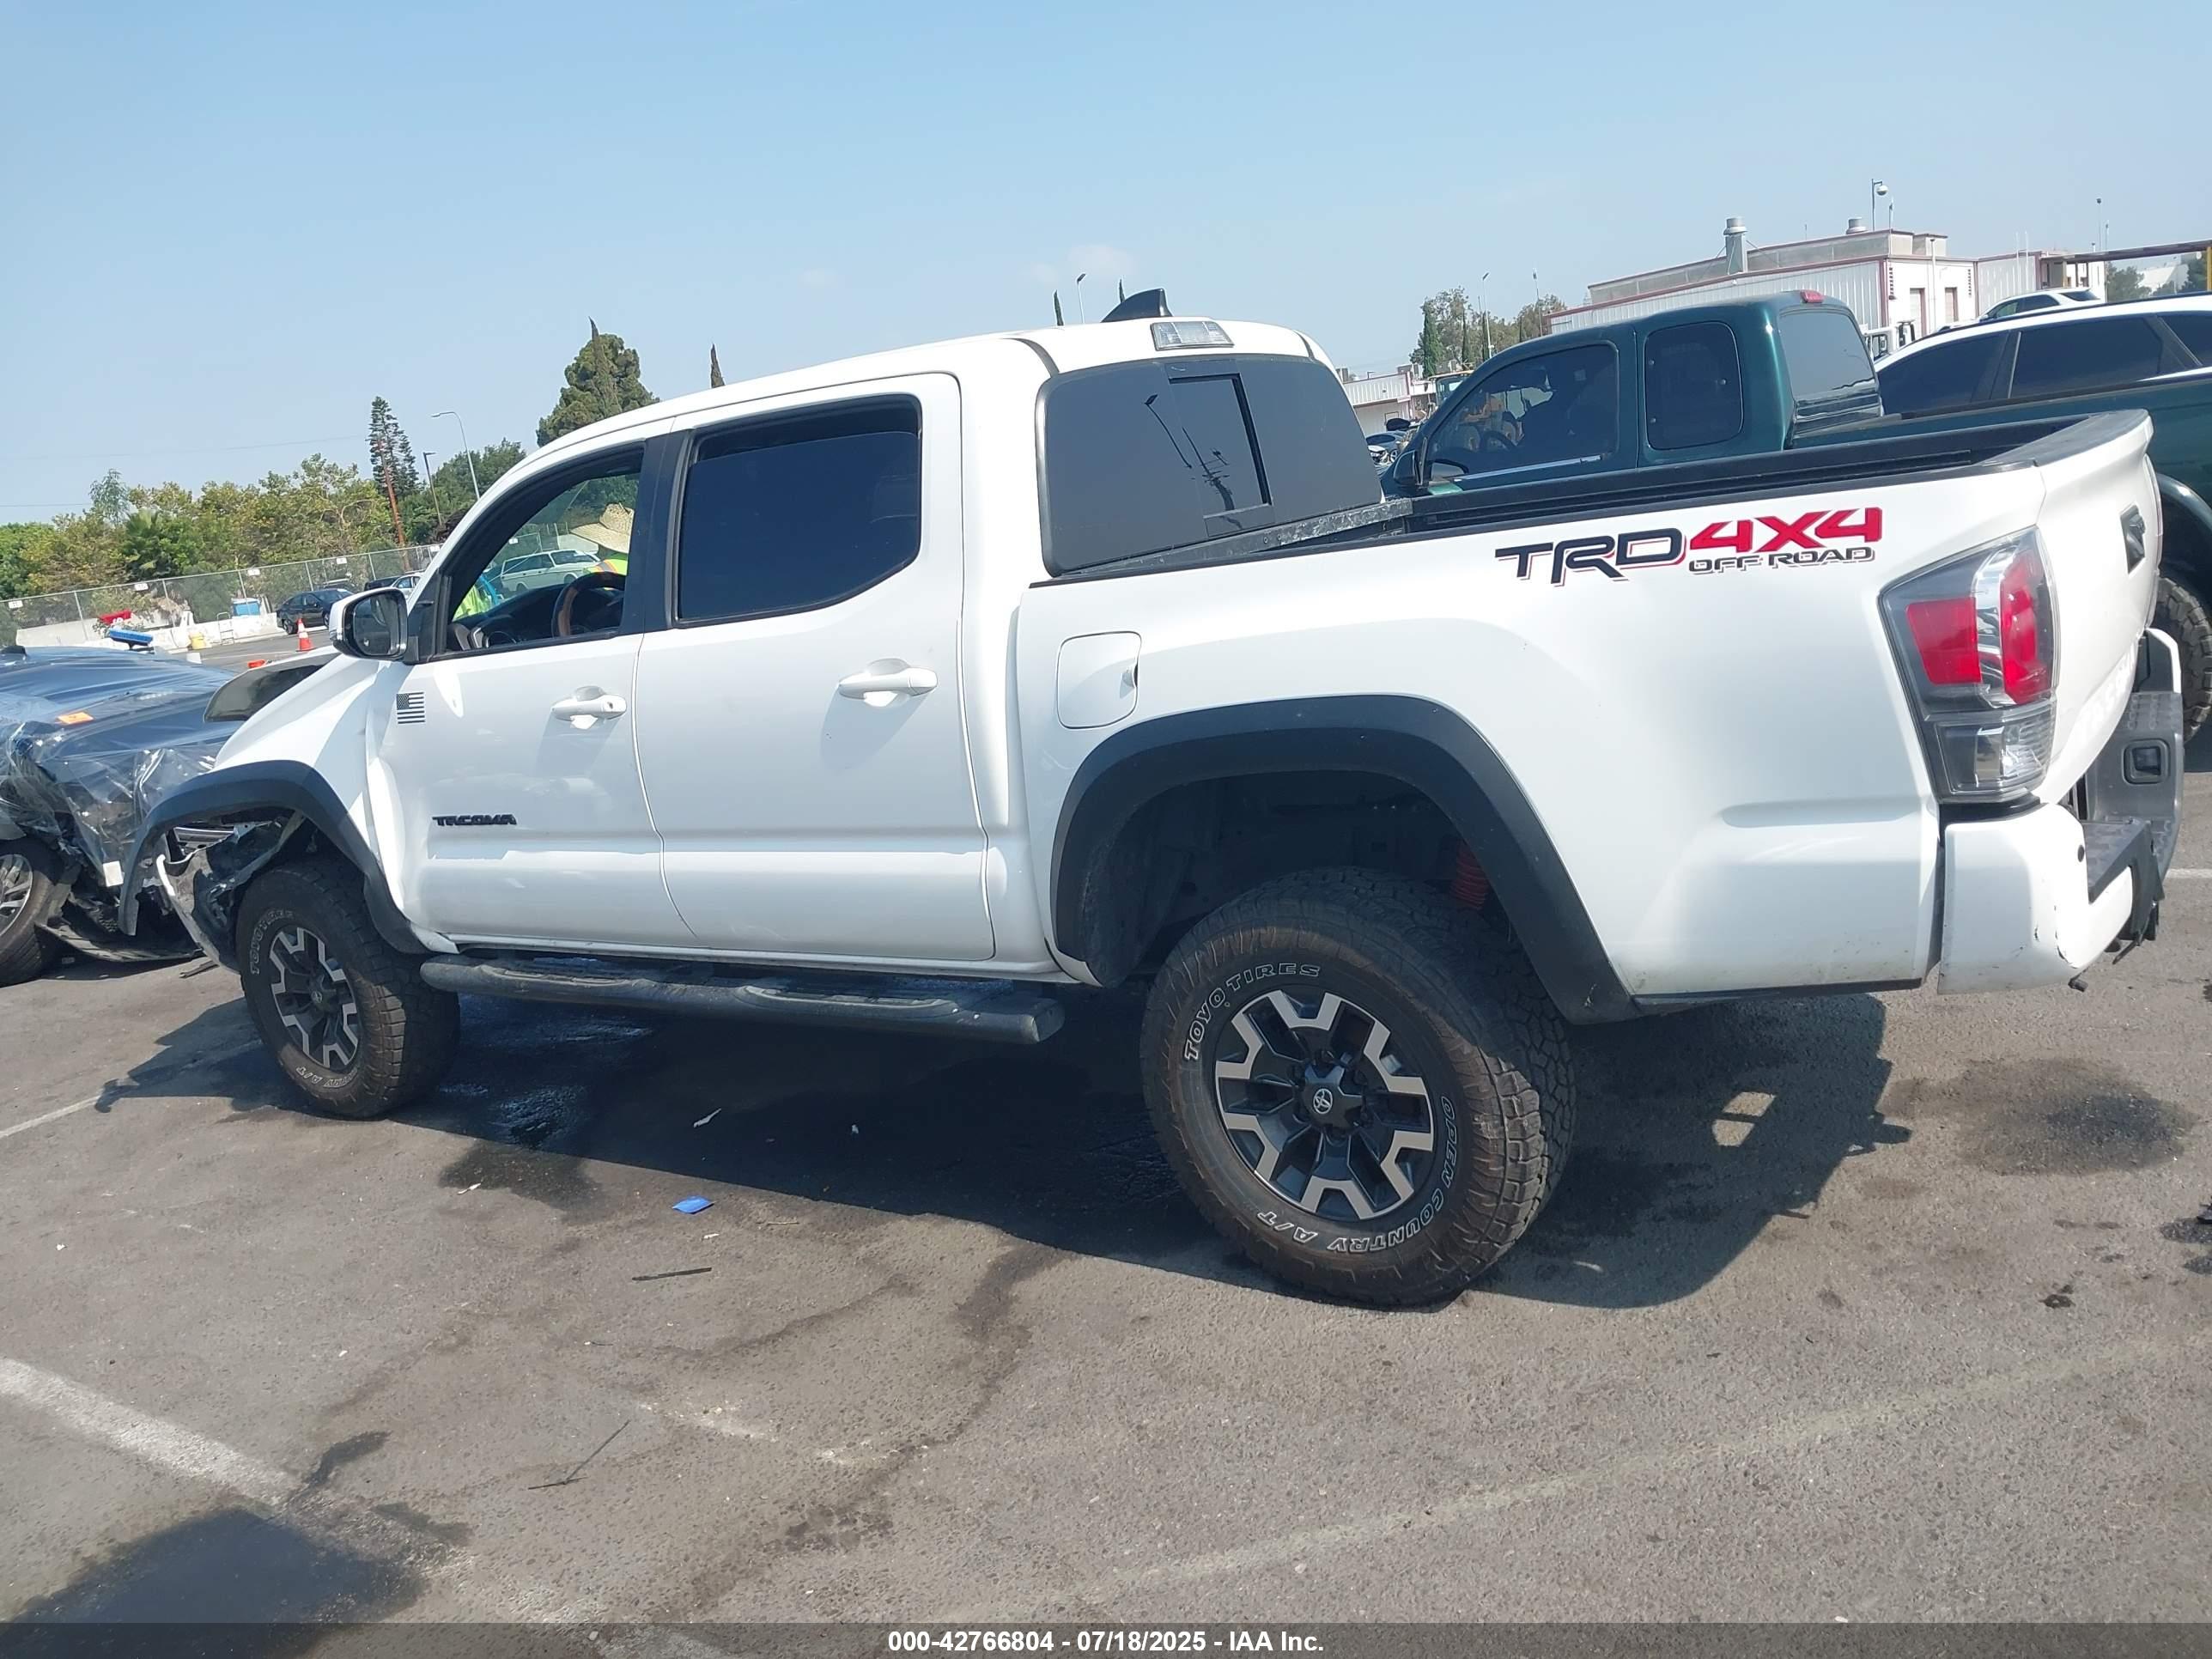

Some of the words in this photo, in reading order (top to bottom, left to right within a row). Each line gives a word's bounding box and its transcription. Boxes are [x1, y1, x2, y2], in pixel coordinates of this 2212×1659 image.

[1495, 527, 1686, 587] TRD
[1689, 507, 1883, 554] 4X4
[1688, 555, 1762, 574] OFF
[1768, 546, 1876, 568] ROAD
[432, 814, 517, 826] TACOMA
[1184, 988, 1226, 1061] TOYO
[1225, 963, 1321, 991] TIRES
[1440, 1096, 1458, 1188] OPEN
[1257, 1211, 1318, 1243] A/T
[1327, 1188, 1444, 1253] COUNTRY
